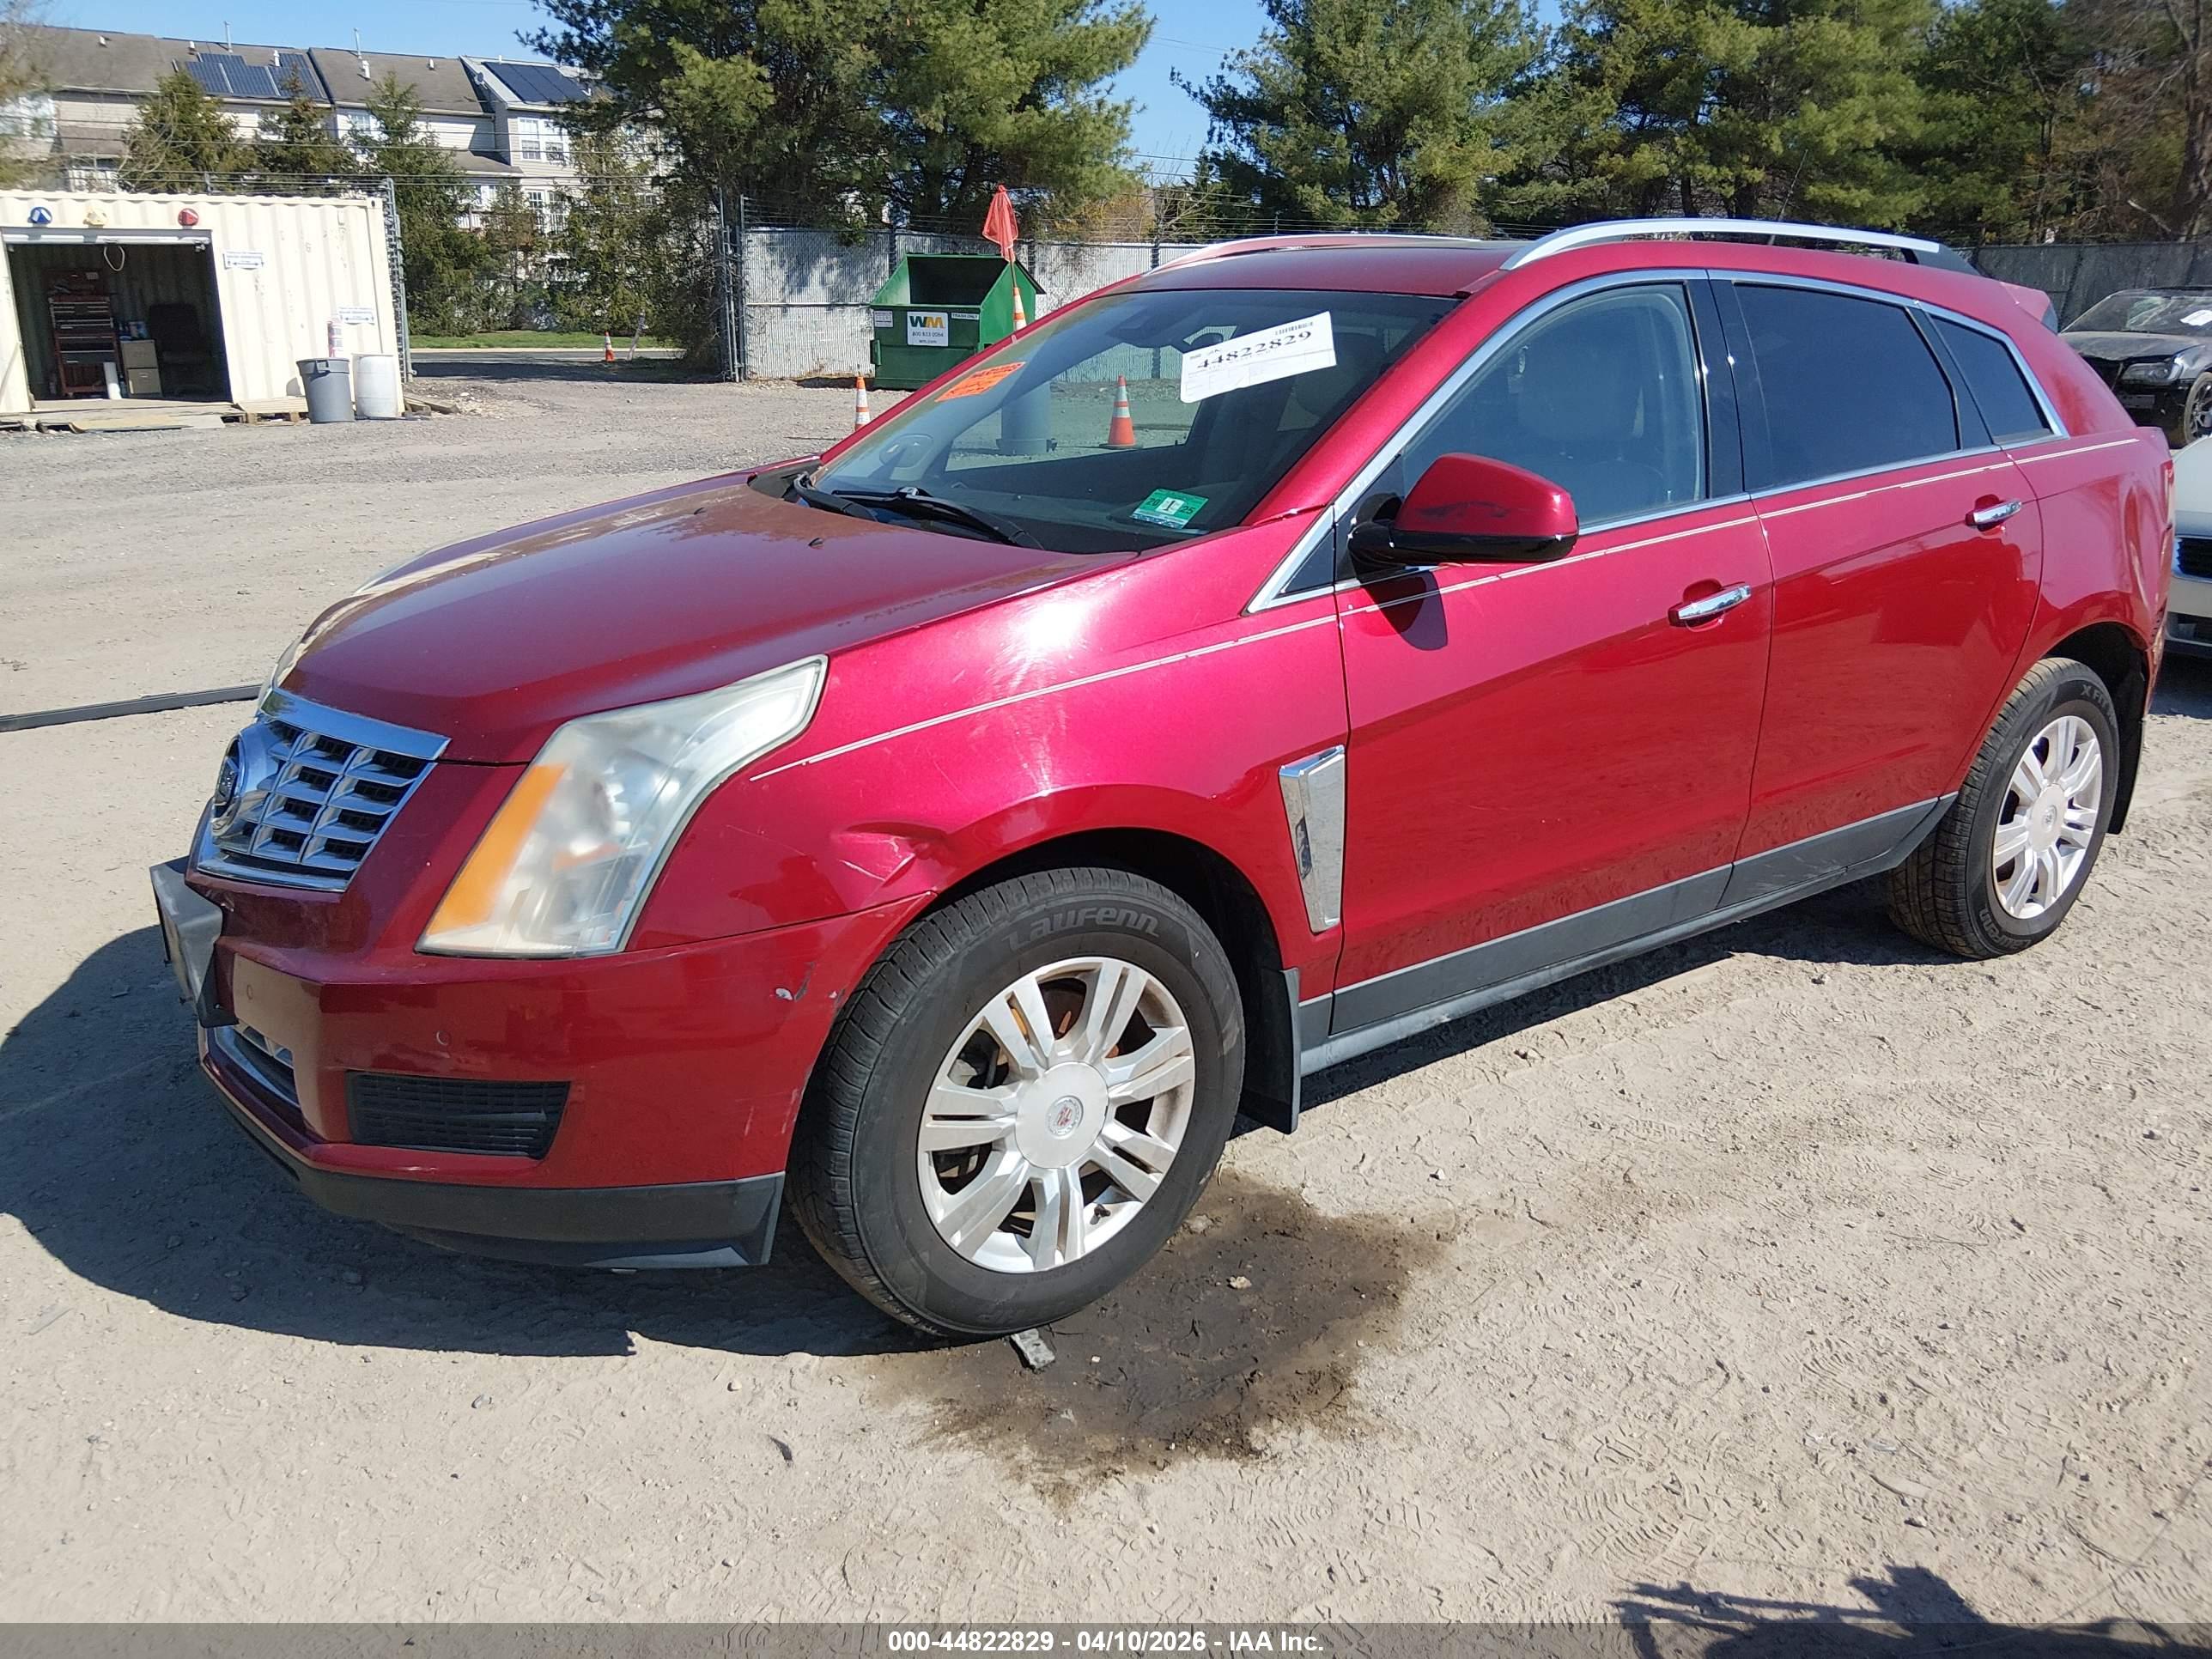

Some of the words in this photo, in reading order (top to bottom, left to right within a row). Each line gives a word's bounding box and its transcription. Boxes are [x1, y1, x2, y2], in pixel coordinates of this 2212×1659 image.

[909, 316, 944, 328] WM
[1197, 331, 1312, 368] 44822829
[1146, 498, 1161, 507] 20
[1163, 500, 1176, 512] 1
[1179, 506, 1195, 514] 25
[1002, 907, 1159, 950] Laurenn
